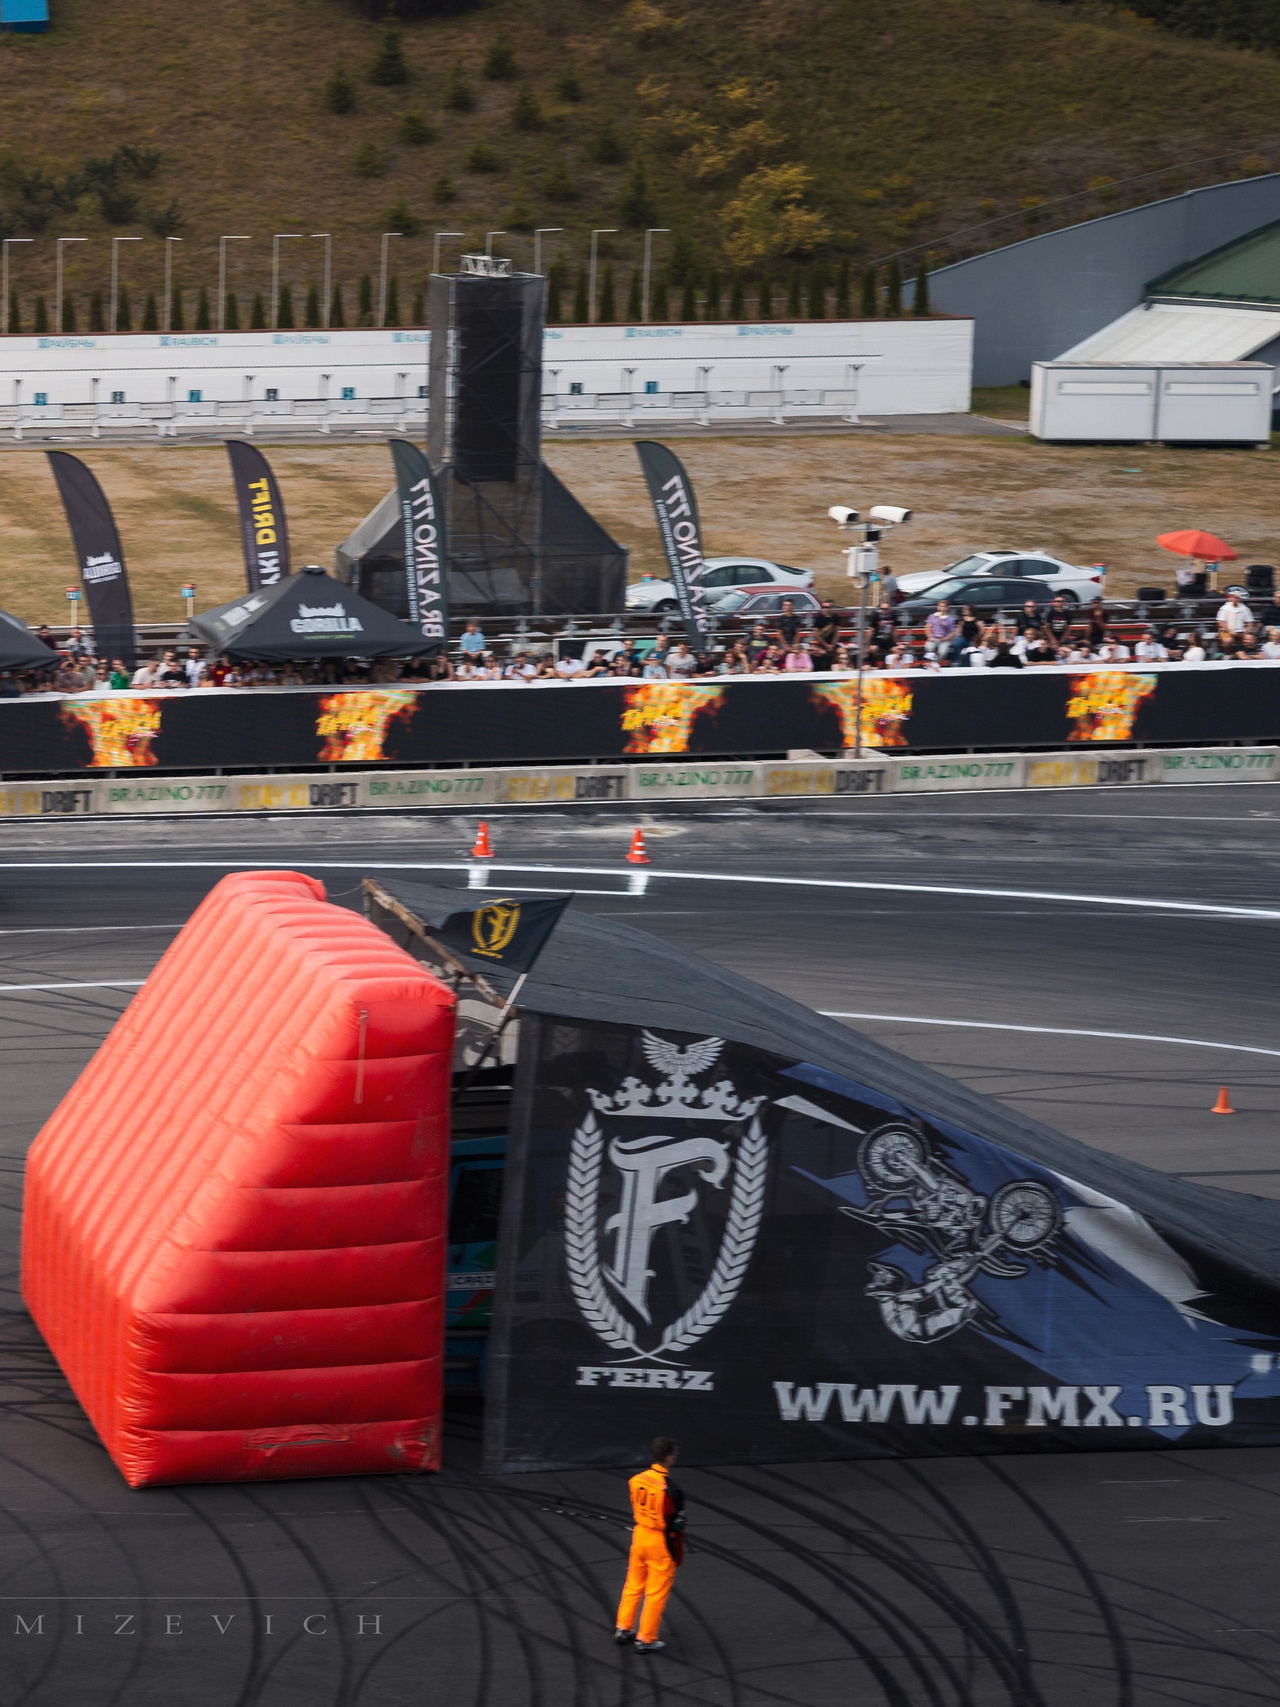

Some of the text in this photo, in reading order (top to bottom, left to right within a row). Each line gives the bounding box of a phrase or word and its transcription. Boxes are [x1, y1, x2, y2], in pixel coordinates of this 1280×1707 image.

[290, 618, 364, 632] GORILLA
[835, 769, 885, 792] DRIFT
[1098, 760, 1147, 782] DRIFT
[309, 783, 359, 806] DRIFT
[575, 775, 626, 798] DRIFT
[42, 790, 92, 813] DRIFT
[576, 1366, 715, 1391] FERZ
[772, 1381, 1235, 1426] WWW.FMX.RU
